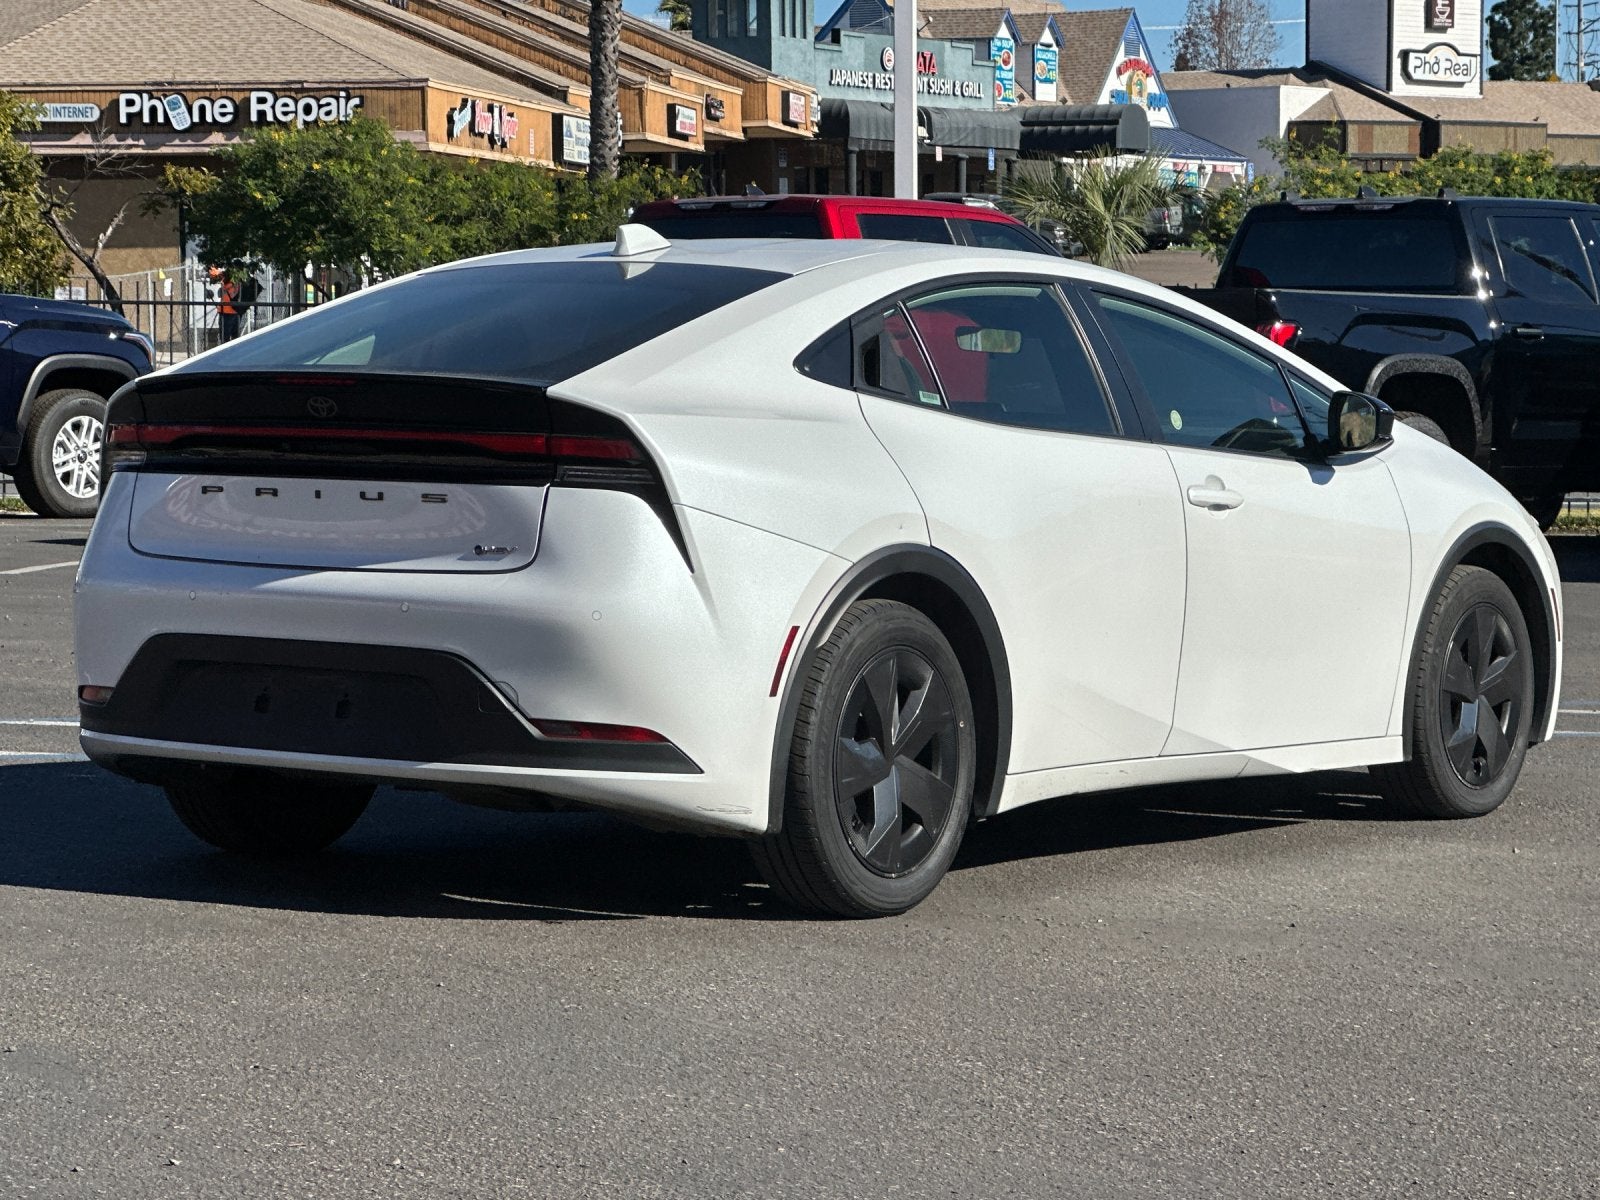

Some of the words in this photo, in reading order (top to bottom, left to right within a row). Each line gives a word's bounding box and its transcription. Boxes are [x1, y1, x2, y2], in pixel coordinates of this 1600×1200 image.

[1444, 58, 1472, 77] Real
[831, 69, 873, 86] JAPANESE
[875, 73, 928, 91] RESTNT
[930, 79, 953, 94] SUSHI
[954, 81, 960, 95] &
[963, 82, 985, 98] GRILL
[52, 105, 95, 118] INTERNET
[250, 91, 362, 128] Repair
[201, 485, 448, 503] PRIUS
